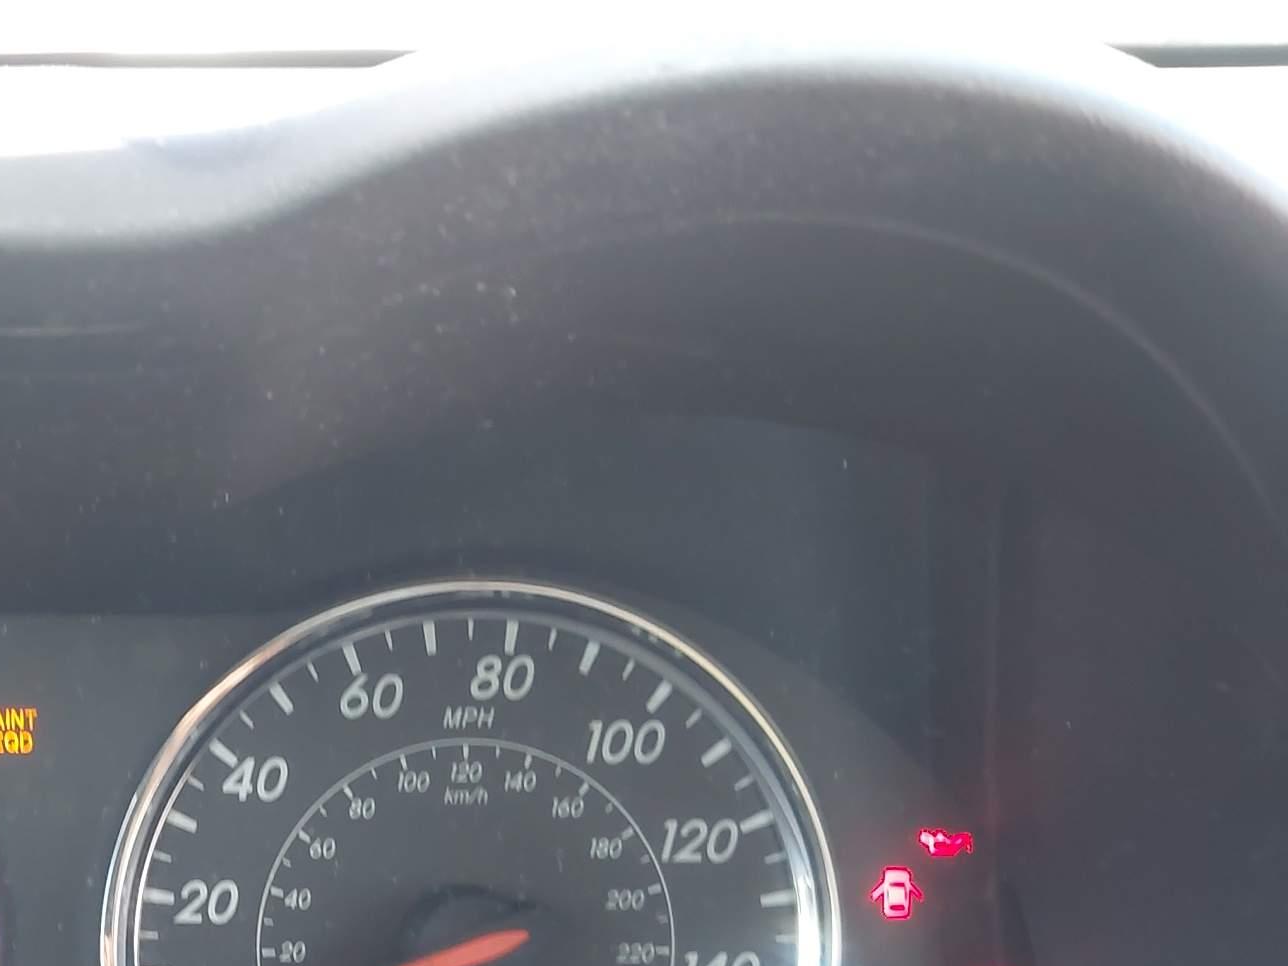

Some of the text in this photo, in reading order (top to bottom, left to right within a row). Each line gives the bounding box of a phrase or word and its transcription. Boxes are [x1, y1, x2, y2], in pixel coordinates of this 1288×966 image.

[470, 655, 535, 700] 80
[339, 673, 404, 719] 60
[443, 706, 495, 729] MPH
[586, 719, 666, 765] 100
[223, 756, 289, 802] 40
[397, 771, 431, 793] 100
[450, 760, 483, 783] 120
[504, 771, 537, 793] 140
[443, 786, 489, 806] km/h
[552, 796, 585, 818] 160
[347, 797, 377, 820] 80
[309, 837, 337, 860] 60
[590, 837, 623, 859] 180
[661, 818, 739, 863] 120
[173, 879, 239, 925] 20
[283, 887, 312, 910] 40
[606, 889, 645, 910] 200
[279, 942, 306, 963] 20
[616, 943, 655, 964] 220
